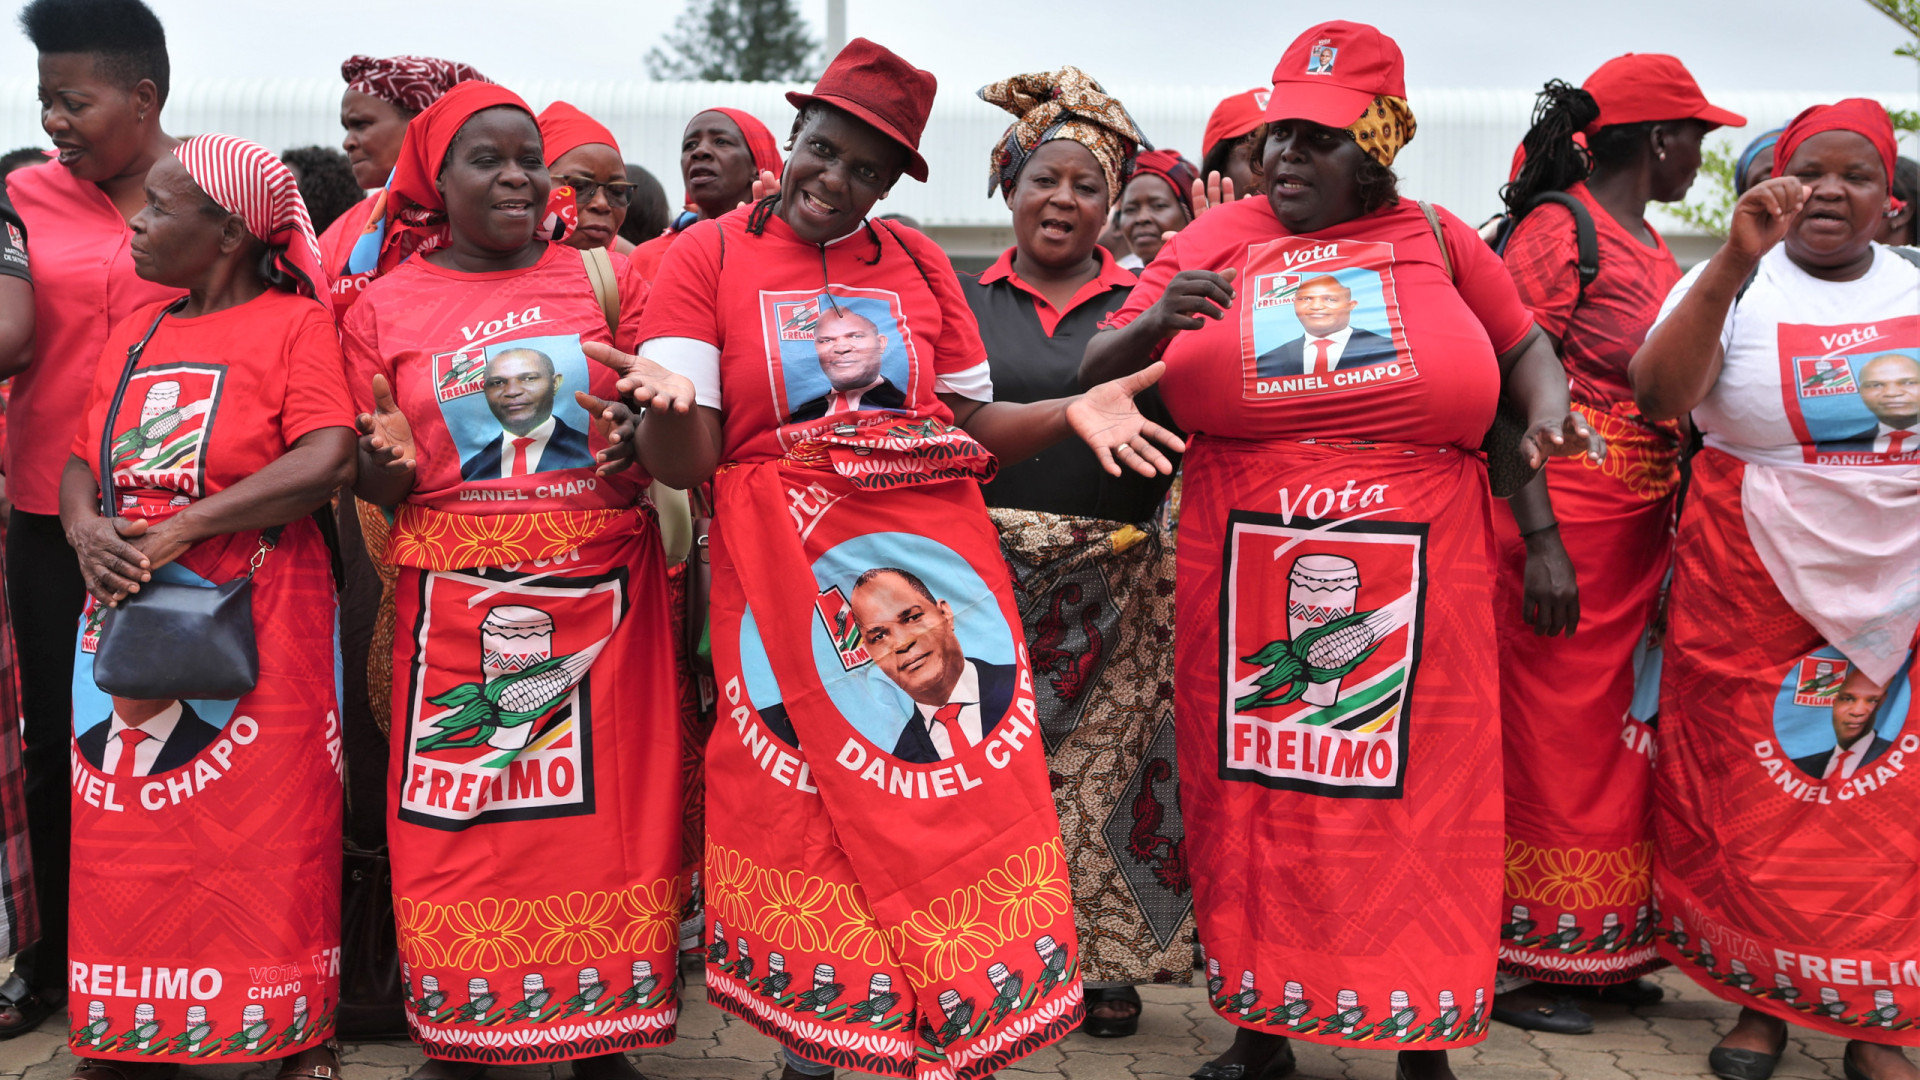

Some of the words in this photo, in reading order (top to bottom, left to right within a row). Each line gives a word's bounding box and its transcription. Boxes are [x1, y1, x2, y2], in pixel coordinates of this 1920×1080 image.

[1283, 243, 1338, 267] Vota
[461, 306, 541, 341] Vota
[783, 331, 815, 339] FRELIM
[1820, 325, 1879, 350] Vota
[1257, 376, 1329, 394] DANIEL
[1334, 364, 1401, 386] CHAPO
[1803, 386, 1855, 397] FRELIMO
[1817, 454, 1885, 466] DANIEL
[460, 489, 529, 502] DANIEL
[535, 478, 597, 499] CHAPO
[1278, 479, 1390, 525] Vota
[725, 675, 819, 795] DANIEL
[140, 715, 259, 811] CHAPO
[1234, 723, 1393, 780] FRELIMO
[835, 737, 983, 799] DANIEL
[1754, 740, 1832, 805] DANIEL
[1837, 734, 1920, 800] CHAPO
[1685, 898, 1771, 968] VOTA
[1774, 948, 1920, 988] FRELIM
[69, 959, 223, 1001] RELIMO
[249, 961, 302, 985] VOTA
[248, 980, 301, 1000] CHAPO
